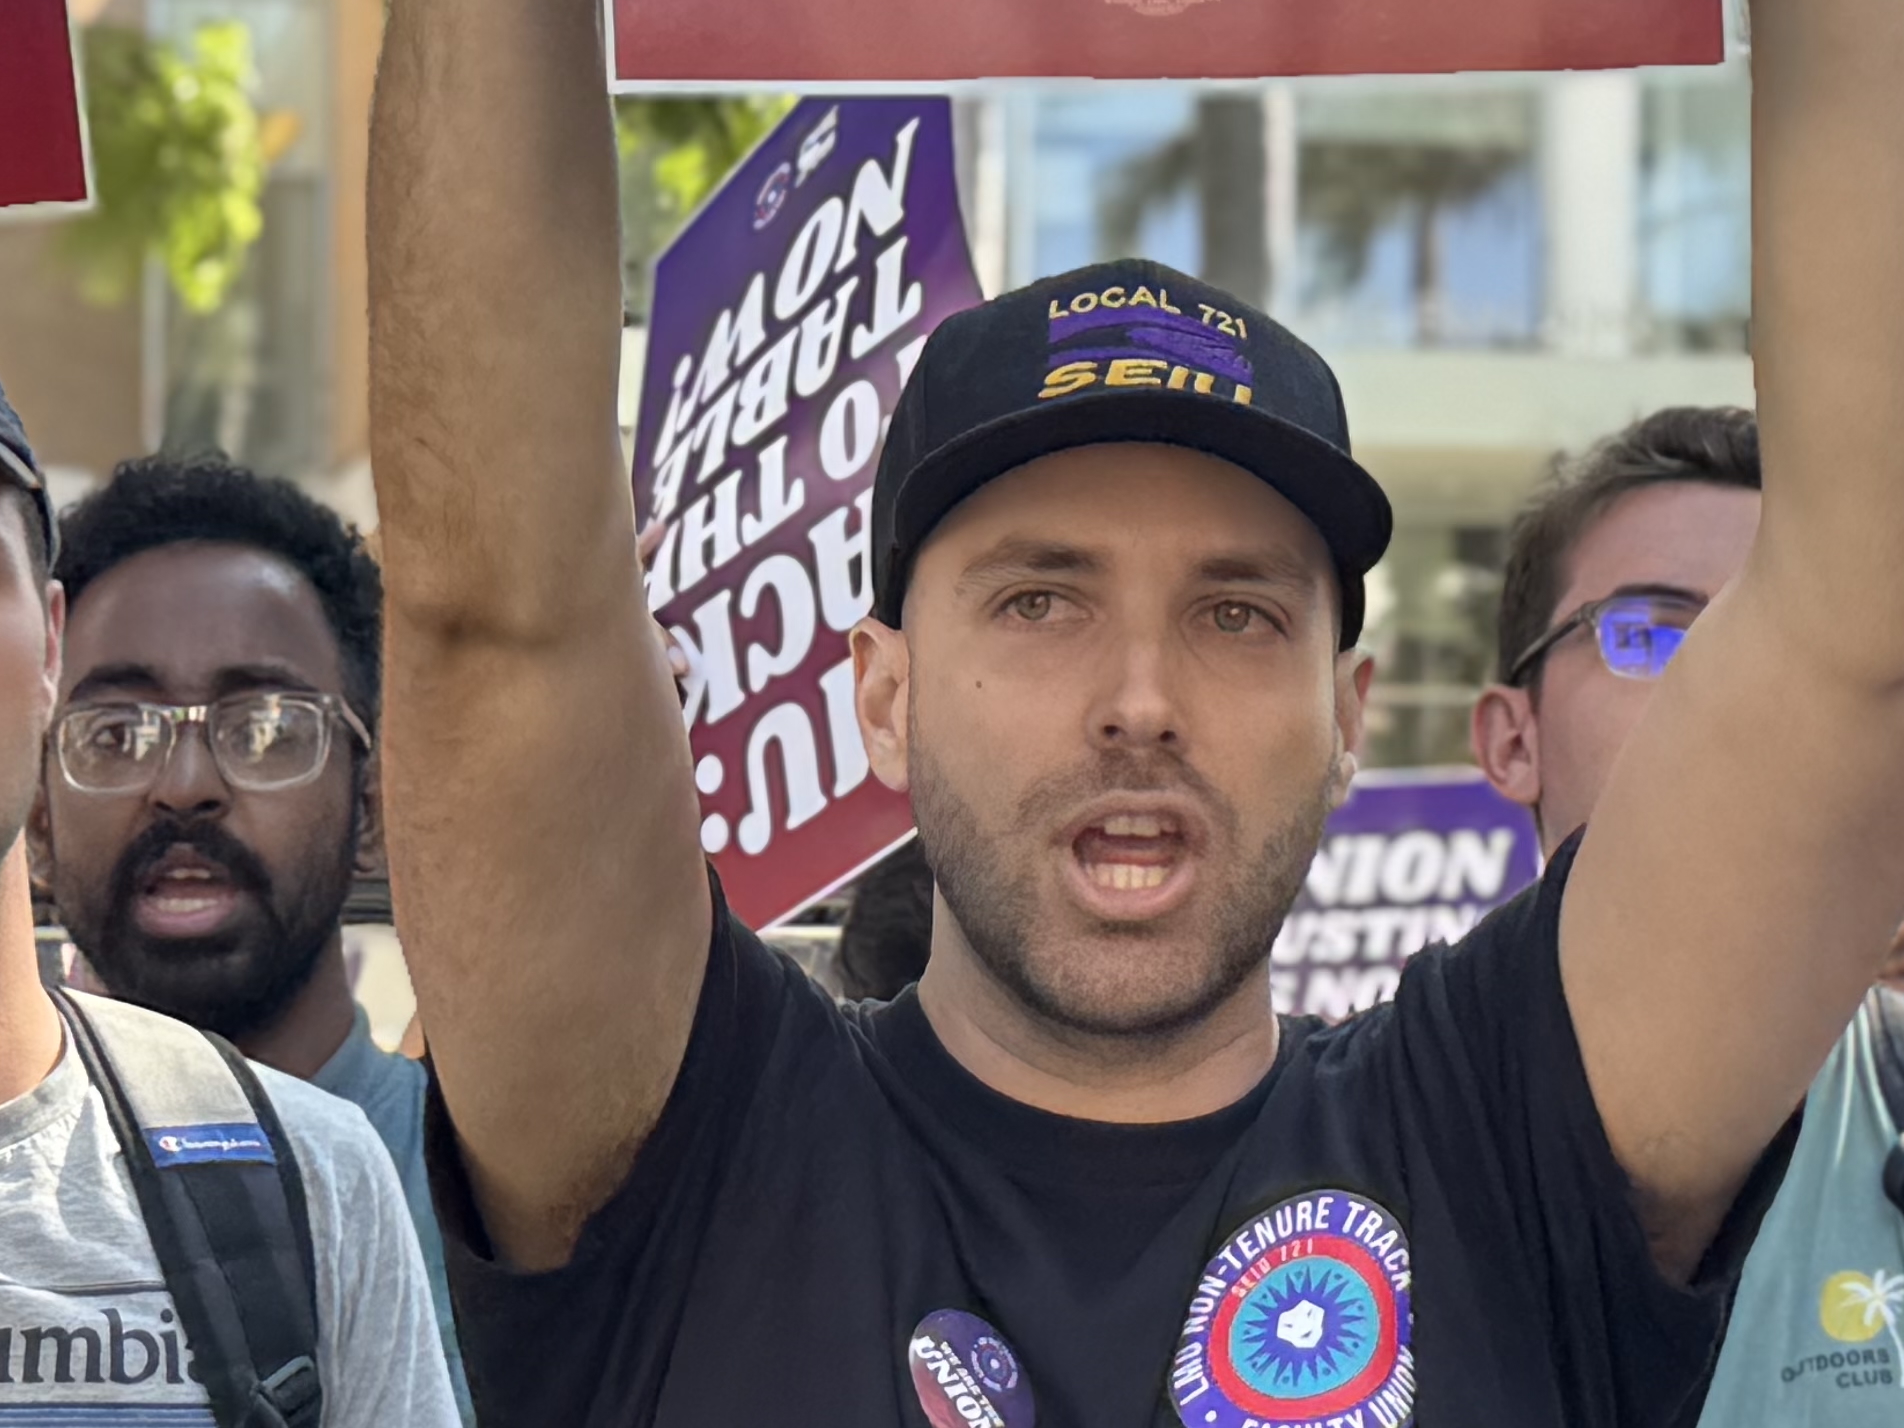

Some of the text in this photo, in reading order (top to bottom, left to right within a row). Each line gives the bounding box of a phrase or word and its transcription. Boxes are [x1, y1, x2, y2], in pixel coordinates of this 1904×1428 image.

[652, 116, 920, 467] NOW!
[1049, 286, 1248, 339] LOCAL 721
[670, 485, 874, 730] ACK
[1306, 827, 1515, 905] NION
[1342, 1201, 1412, 1291] TRACK
[1836, 1369, 1893, 1389] CLUB
